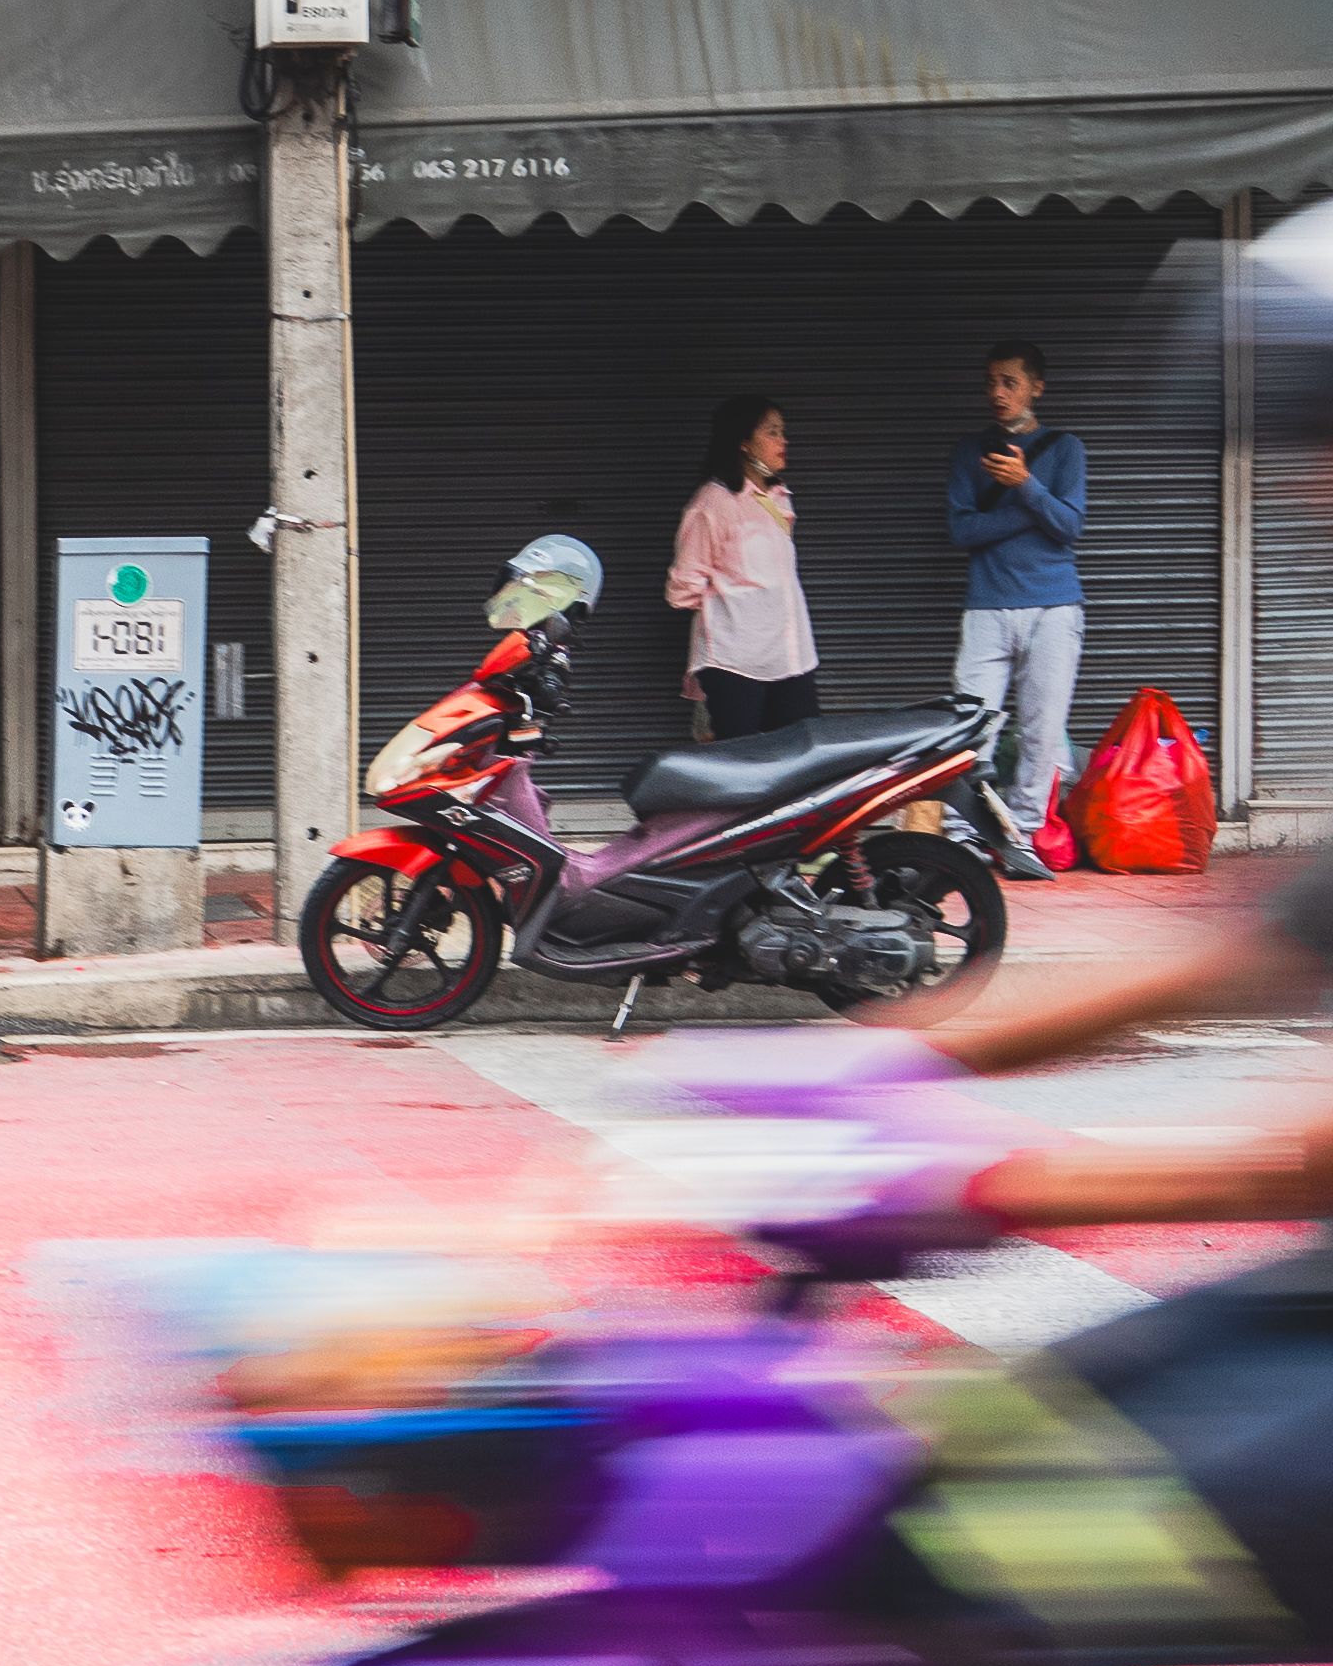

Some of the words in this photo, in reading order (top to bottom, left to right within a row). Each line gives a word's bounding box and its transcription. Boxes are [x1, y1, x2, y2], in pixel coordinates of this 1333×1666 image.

[413, 159, 457, 179] 063
[462, 158, 507, 179] 217
[512, 156, 571, 177] 6116
